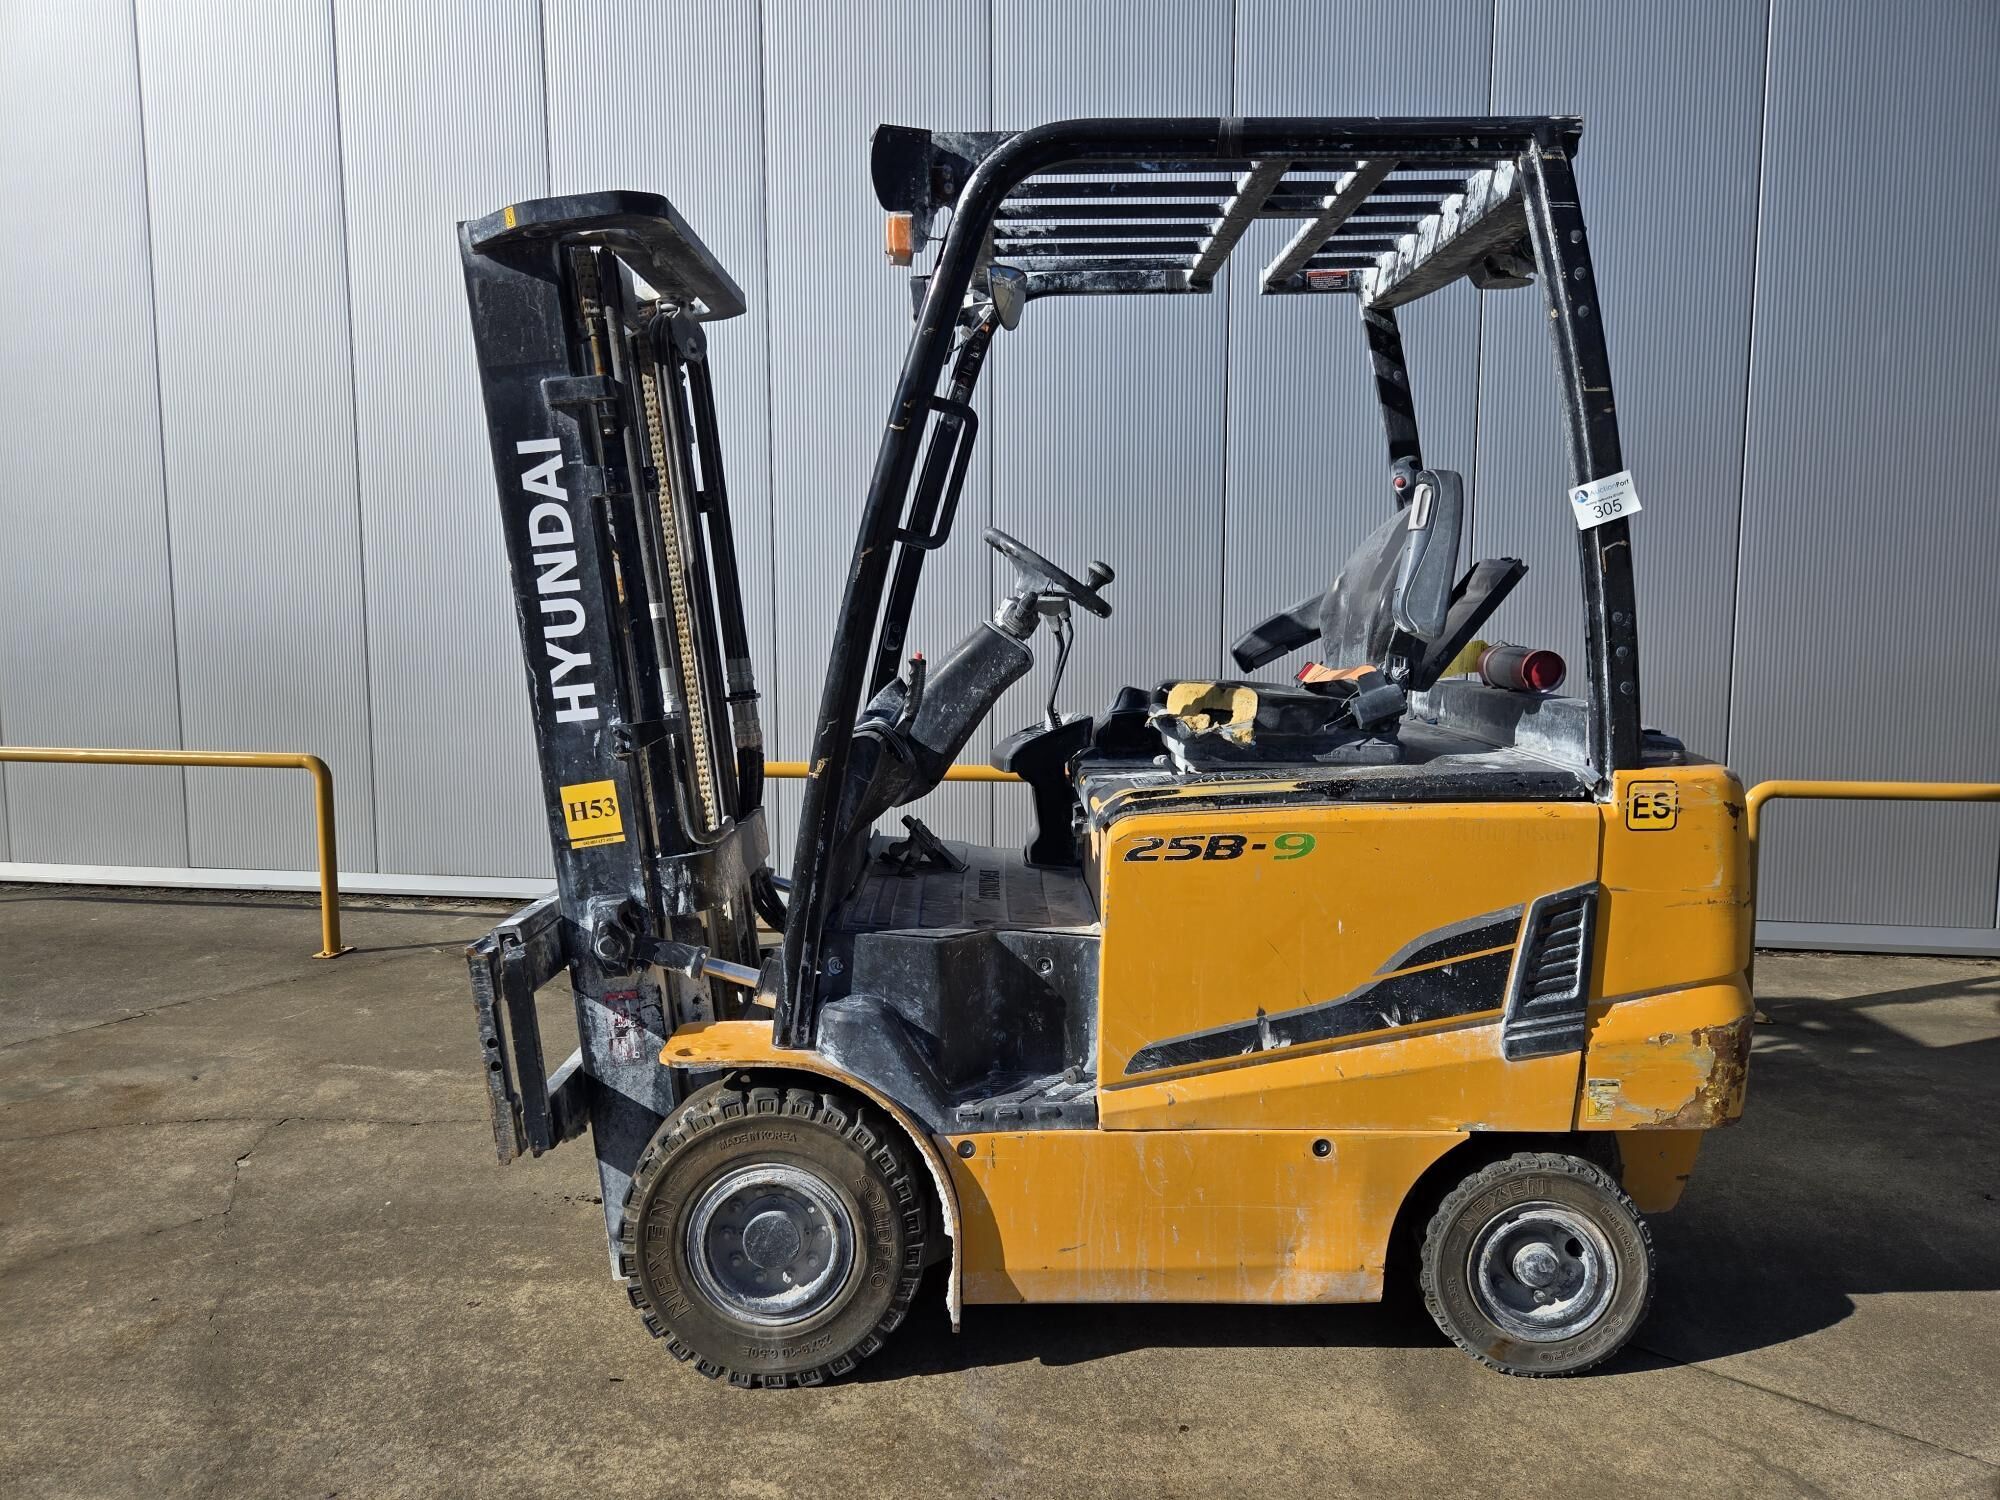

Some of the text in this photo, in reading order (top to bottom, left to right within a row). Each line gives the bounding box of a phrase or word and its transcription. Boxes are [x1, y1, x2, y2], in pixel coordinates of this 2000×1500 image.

[1593, 499, 1622, 519] 305
[516, 437, 599, 724] HYUNDAI
[568, 797, 616, 822] H53
[1633, 792, 1670, 819] ES
[1124, 832, 1316, 862] 25B-9
[720, 1130, 797, 1150] MADE IN KOREA
[1459, 1177, 1545, 1232] NEXEN
[647, 1198, 692, 1320] NEXEN
